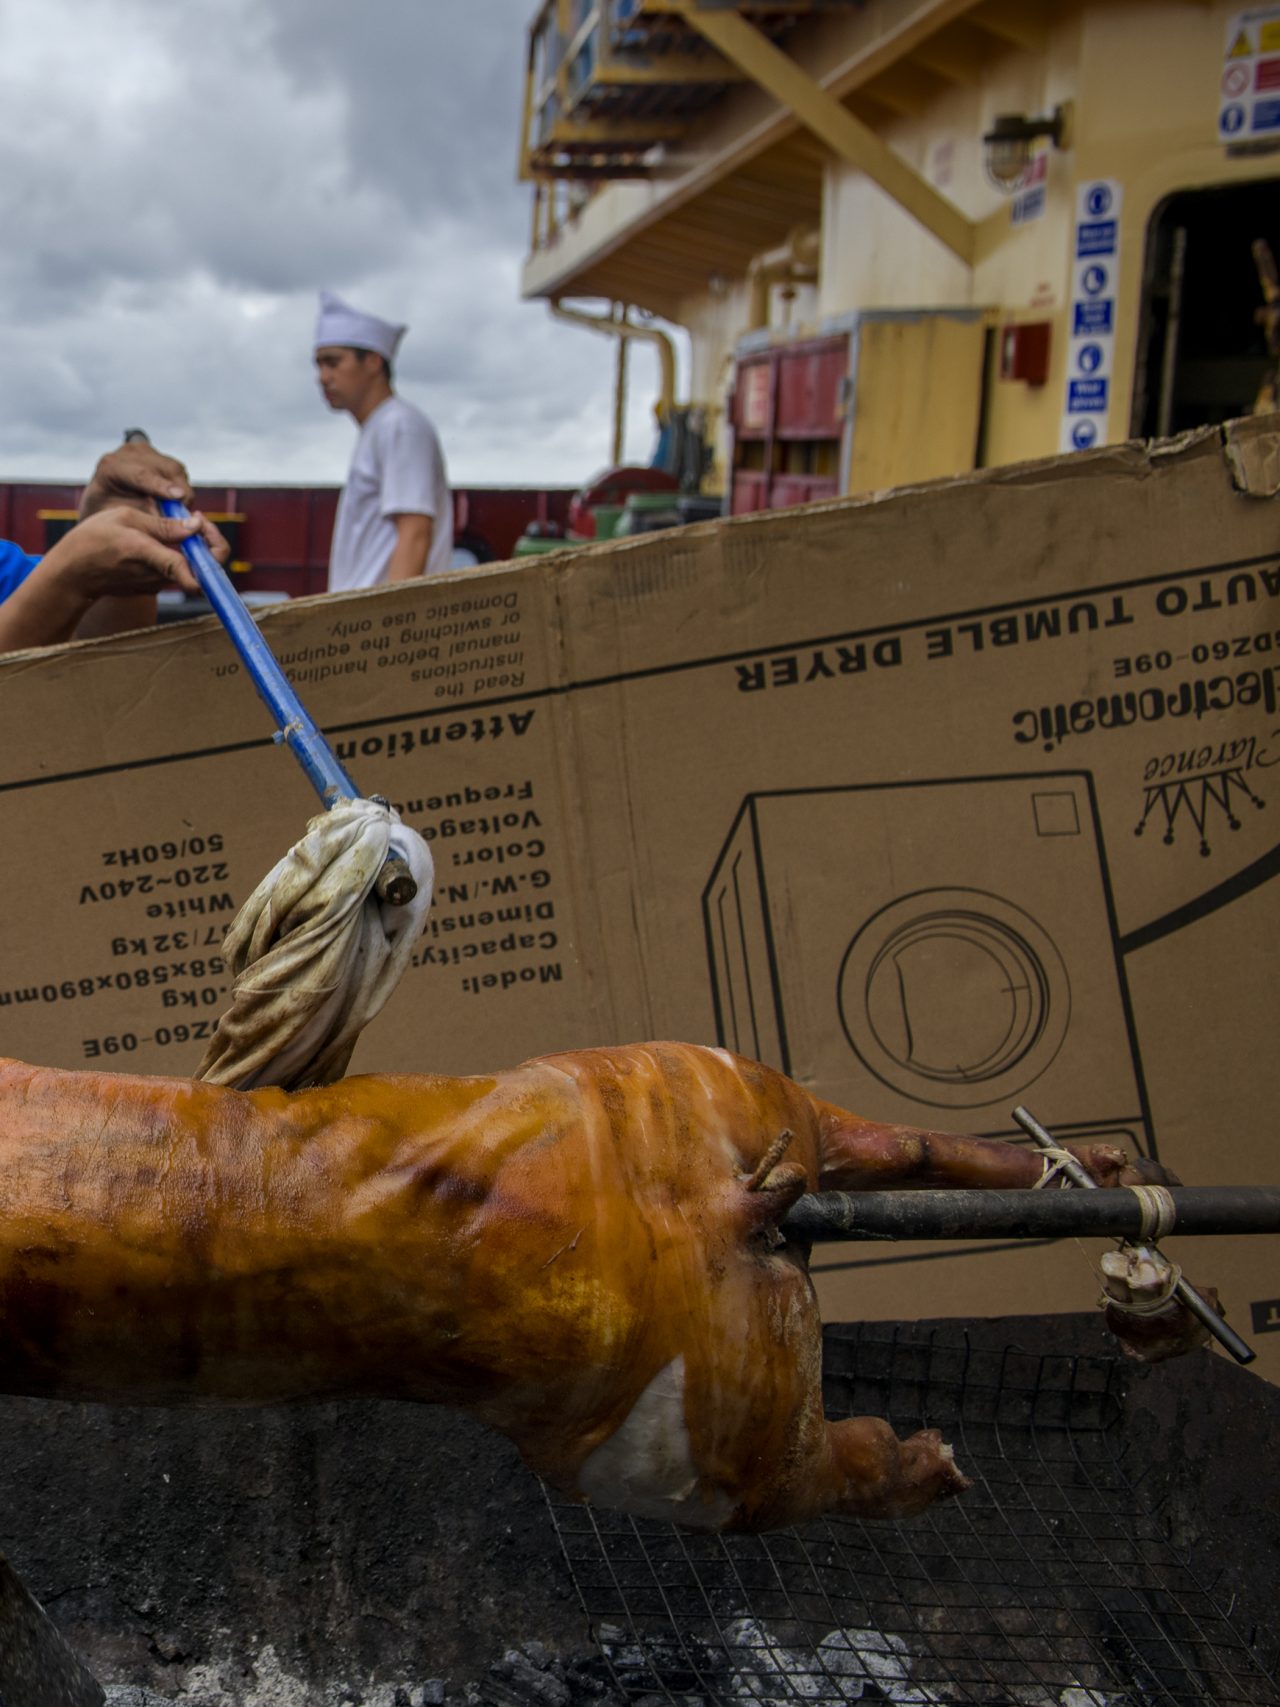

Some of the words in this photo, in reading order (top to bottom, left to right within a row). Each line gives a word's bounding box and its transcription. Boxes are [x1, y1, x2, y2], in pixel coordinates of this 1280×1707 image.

[426, 592, 518, 620] Domestic
[1156, 567, 1280, 617] AUTO
[327, 620, 372, 637] only.
[382, 612, 416, 628] use
[400, 617, 492, 645] switching
[501, 611, 520, 626] or
[926, 596, 1134, 660] TUMBLE
[276, 642, 350, 666] equipm
[360, 636, 390, 652] the
[377, 646, 439, 668] before
[448, 632, 520, 656] manual
[210, 663, 239, 678] on.
[285, 659, 368, 684] handling
[410, 652, 524, 683] instructions
[734, 637, 902, 693] DRYER
[434, 682, 464, 698] the
[474, 672, 524, 693] Read
[1012, 666, 1280, 752] lectromatic
[335, 709, 534, 761] Attention
[101, 834, 224, 867] 50/60Hz
[452, 839, 545, 867] Color:
[78, 862, 229, 905] 220~240V
[431, 868, 550, 908] G.W./N.
[146, 892, 234, 919] White
[153, 924, 230, 953] 7/32
[412, 931, 558, 968] Capacity:
[462, 963, 563, 994] Model:
